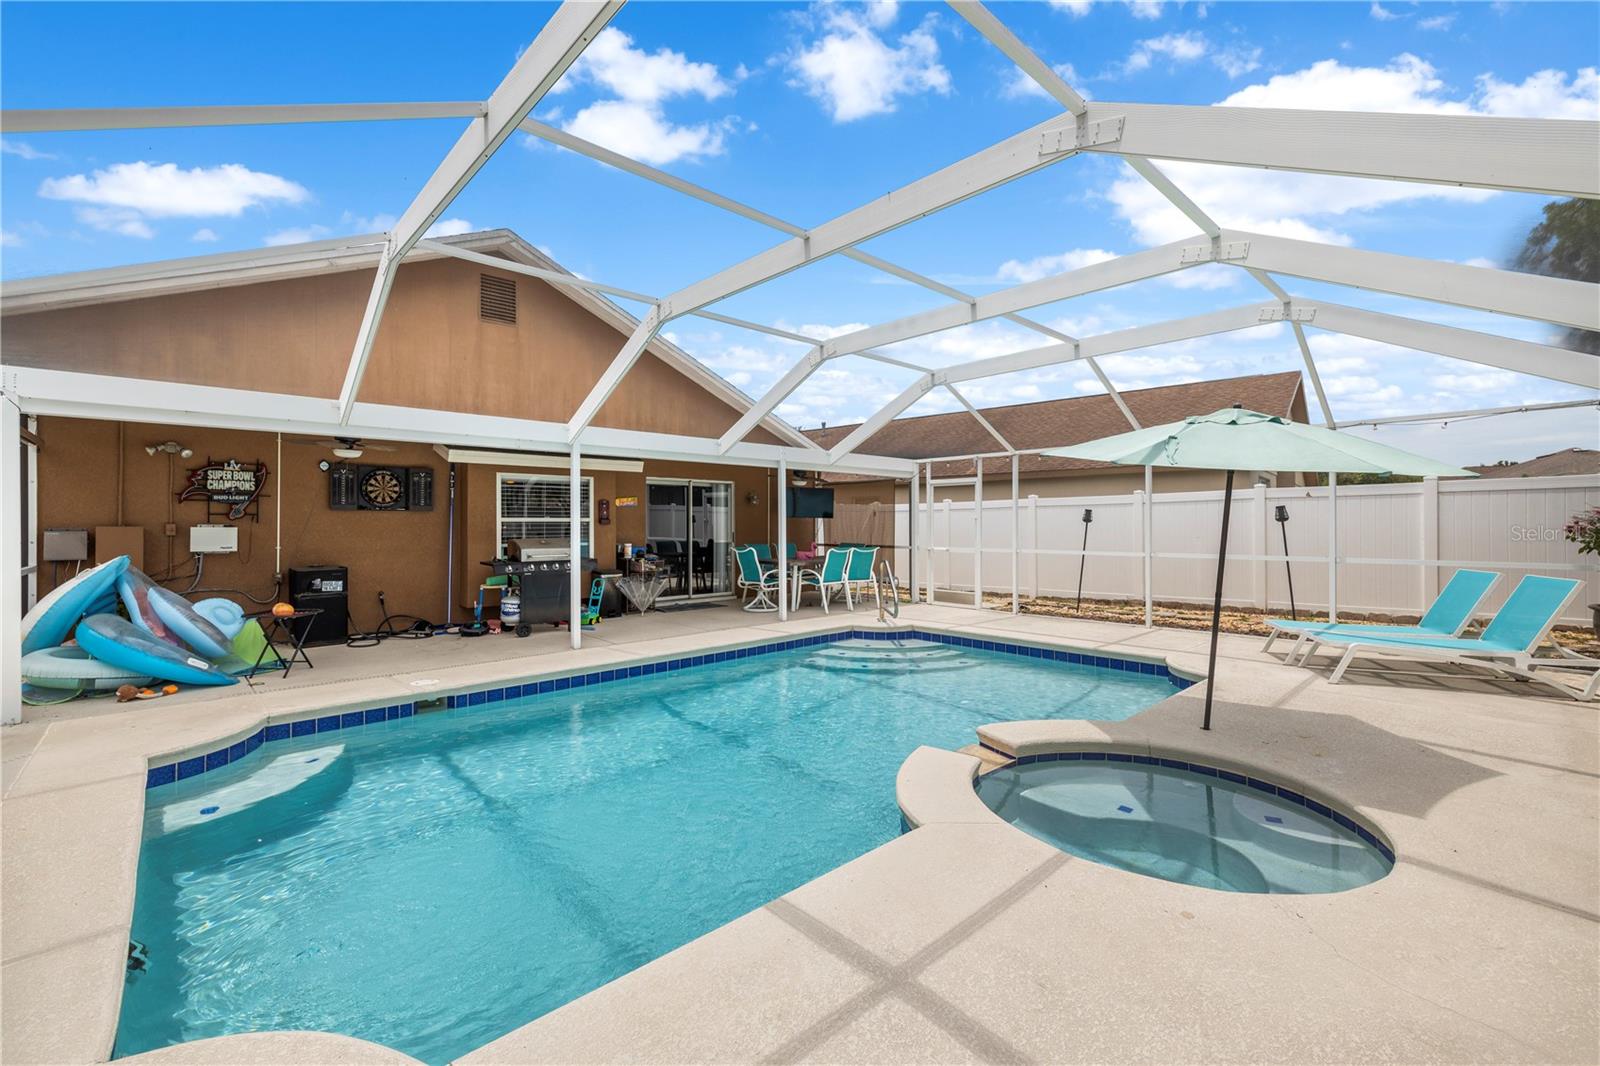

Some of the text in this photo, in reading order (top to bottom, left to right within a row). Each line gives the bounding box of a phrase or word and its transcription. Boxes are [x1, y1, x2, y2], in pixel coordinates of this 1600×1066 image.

[207, 470, 256, 481] SUPER BOWL
[207, 480, 256, 491] CHAMPIONS
